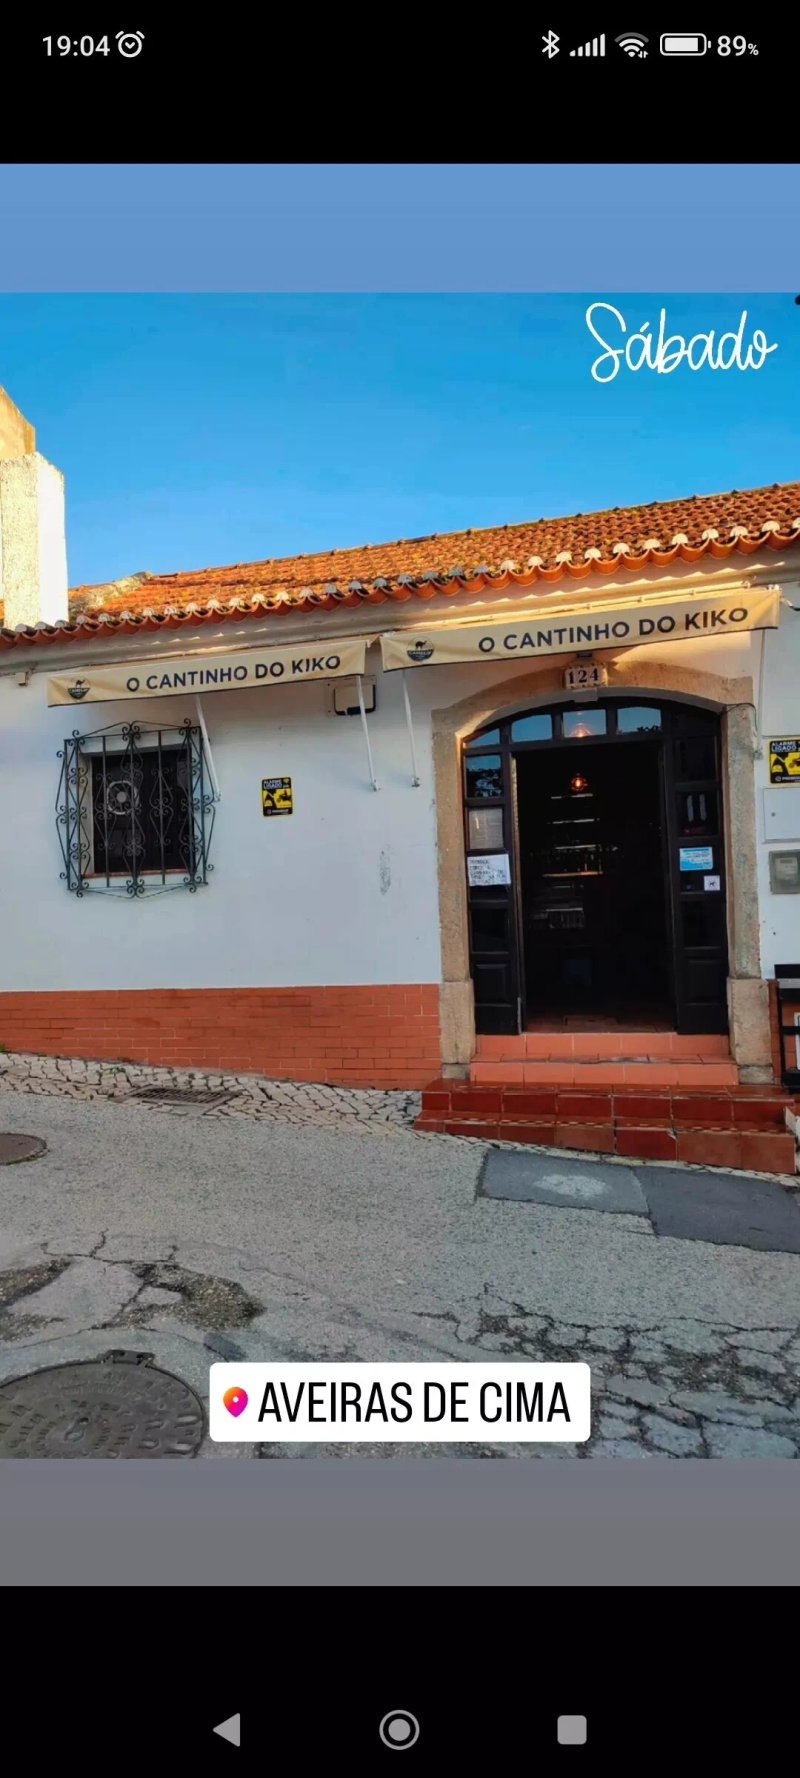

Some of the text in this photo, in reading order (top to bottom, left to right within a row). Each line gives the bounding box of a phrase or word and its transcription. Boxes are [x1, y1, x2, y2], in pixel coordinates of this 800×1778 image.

[478, 608, 748, 654] O CANTINHO DO KIKO
[126, 655, 341, 693] O CANTINHO DO KIKO
[568, 667, 599, 685] 124
